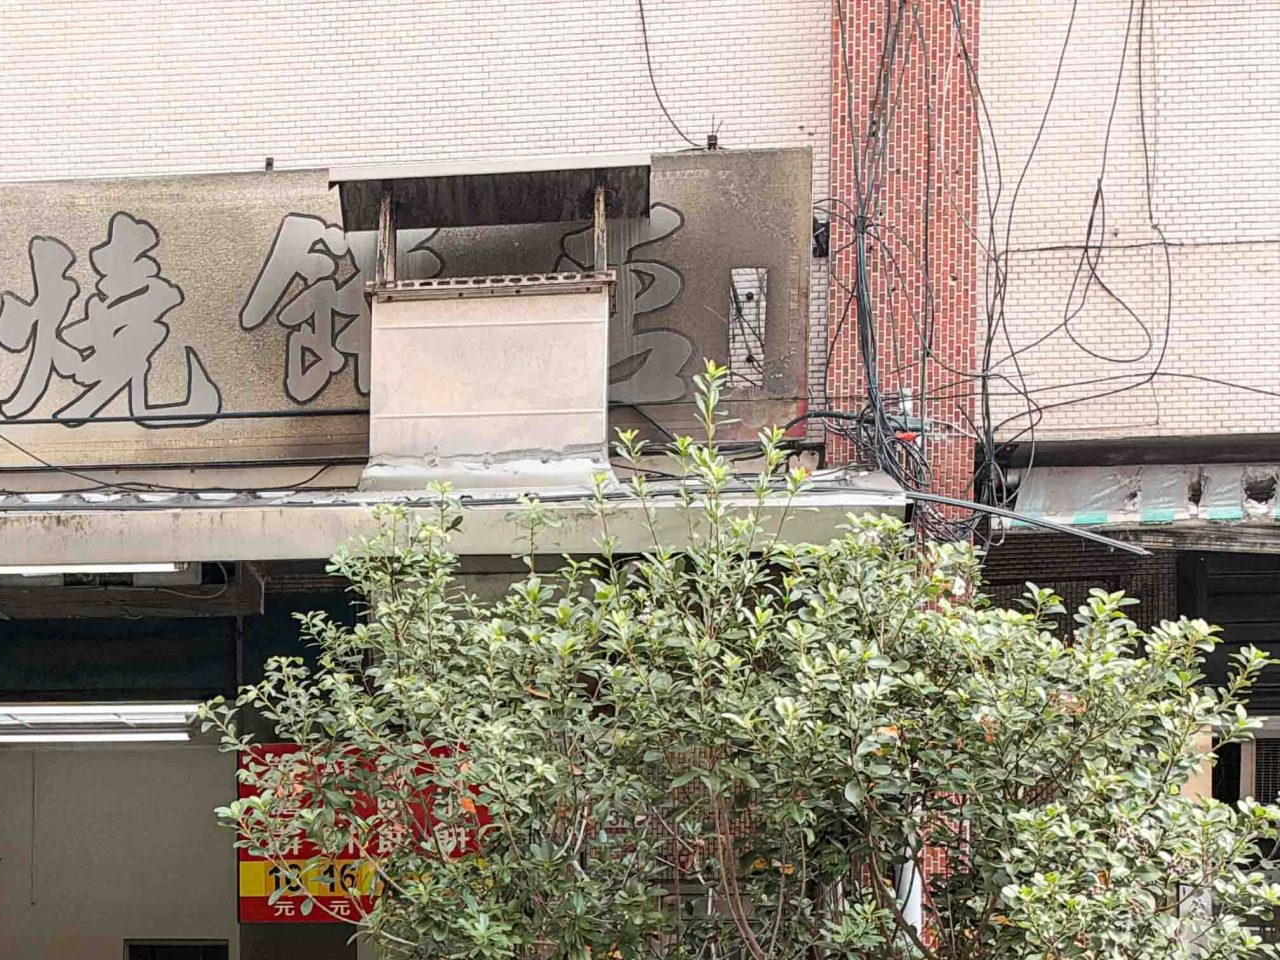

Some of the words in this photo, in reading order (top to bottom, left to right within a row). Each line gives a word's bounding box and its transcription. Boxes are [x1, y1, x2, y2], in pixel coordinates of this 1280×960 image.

[322, 864, 357, 892] 16
[274, 901, 295, 917] 元
[330, 900, 351, 916] 元
